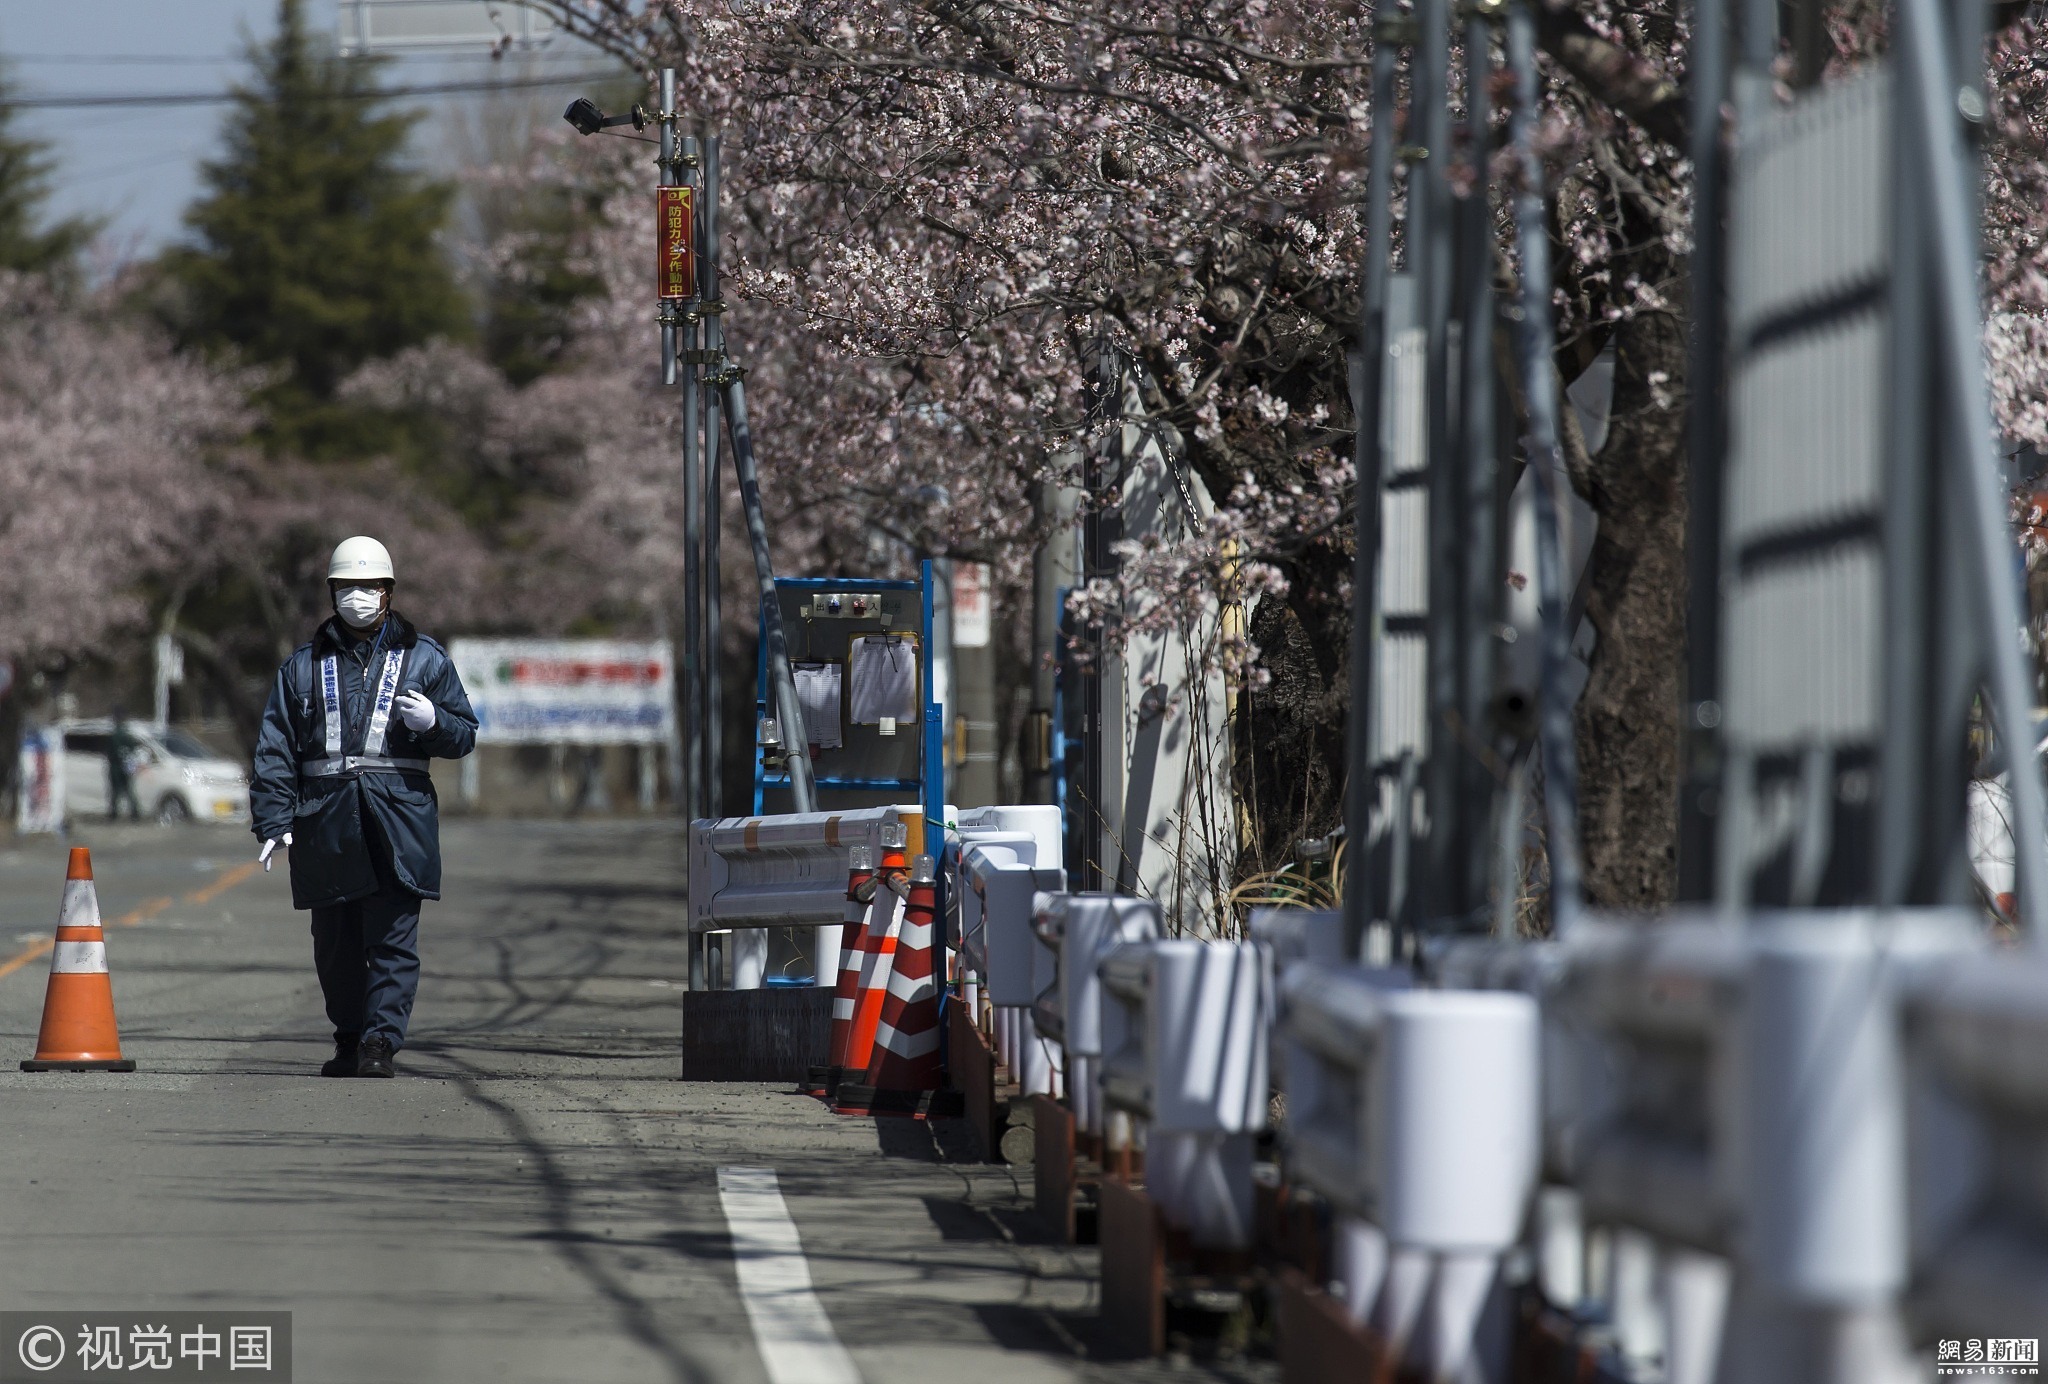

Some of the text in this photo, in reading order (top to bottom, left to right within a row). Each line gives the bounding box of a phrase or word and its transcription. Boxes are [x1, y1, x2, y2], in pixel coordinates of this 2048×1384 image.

[668, 206, 683, 295] 防犯カメラ作動中
[816, 602, 825, 611] 出
[869, 602, 878, 611] 入
